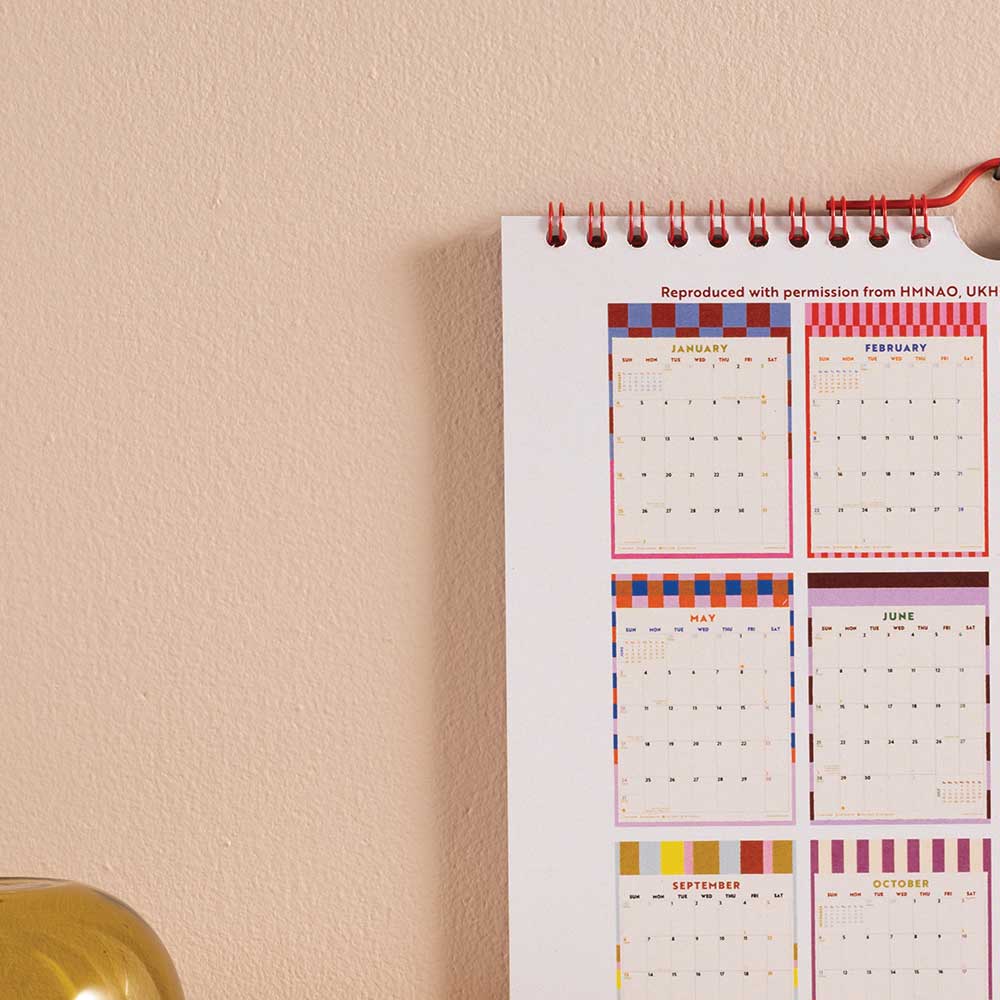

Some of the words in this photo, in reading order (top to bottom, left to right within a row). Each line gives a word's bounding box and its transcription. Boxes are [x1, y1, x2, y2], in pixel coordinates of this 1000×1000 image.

[662, 286, 744, 300] Reproduced
[749, 286, 778, 297] with
[784, 286, 858, 300] permission
[863, 286, 895, 297] from
[901, 286, 961, 298] HMNAO,
[672, 344, 728, 353] JANUARY
[866, 344, 926, 352] FEBRUARY
[690, 614, 715, 622] MAY
[883, 612, 914, 620] JUNE
[673, 882, 740, 890] SEPTEMBER
[873, 880, 928, 888] OCTOBER
